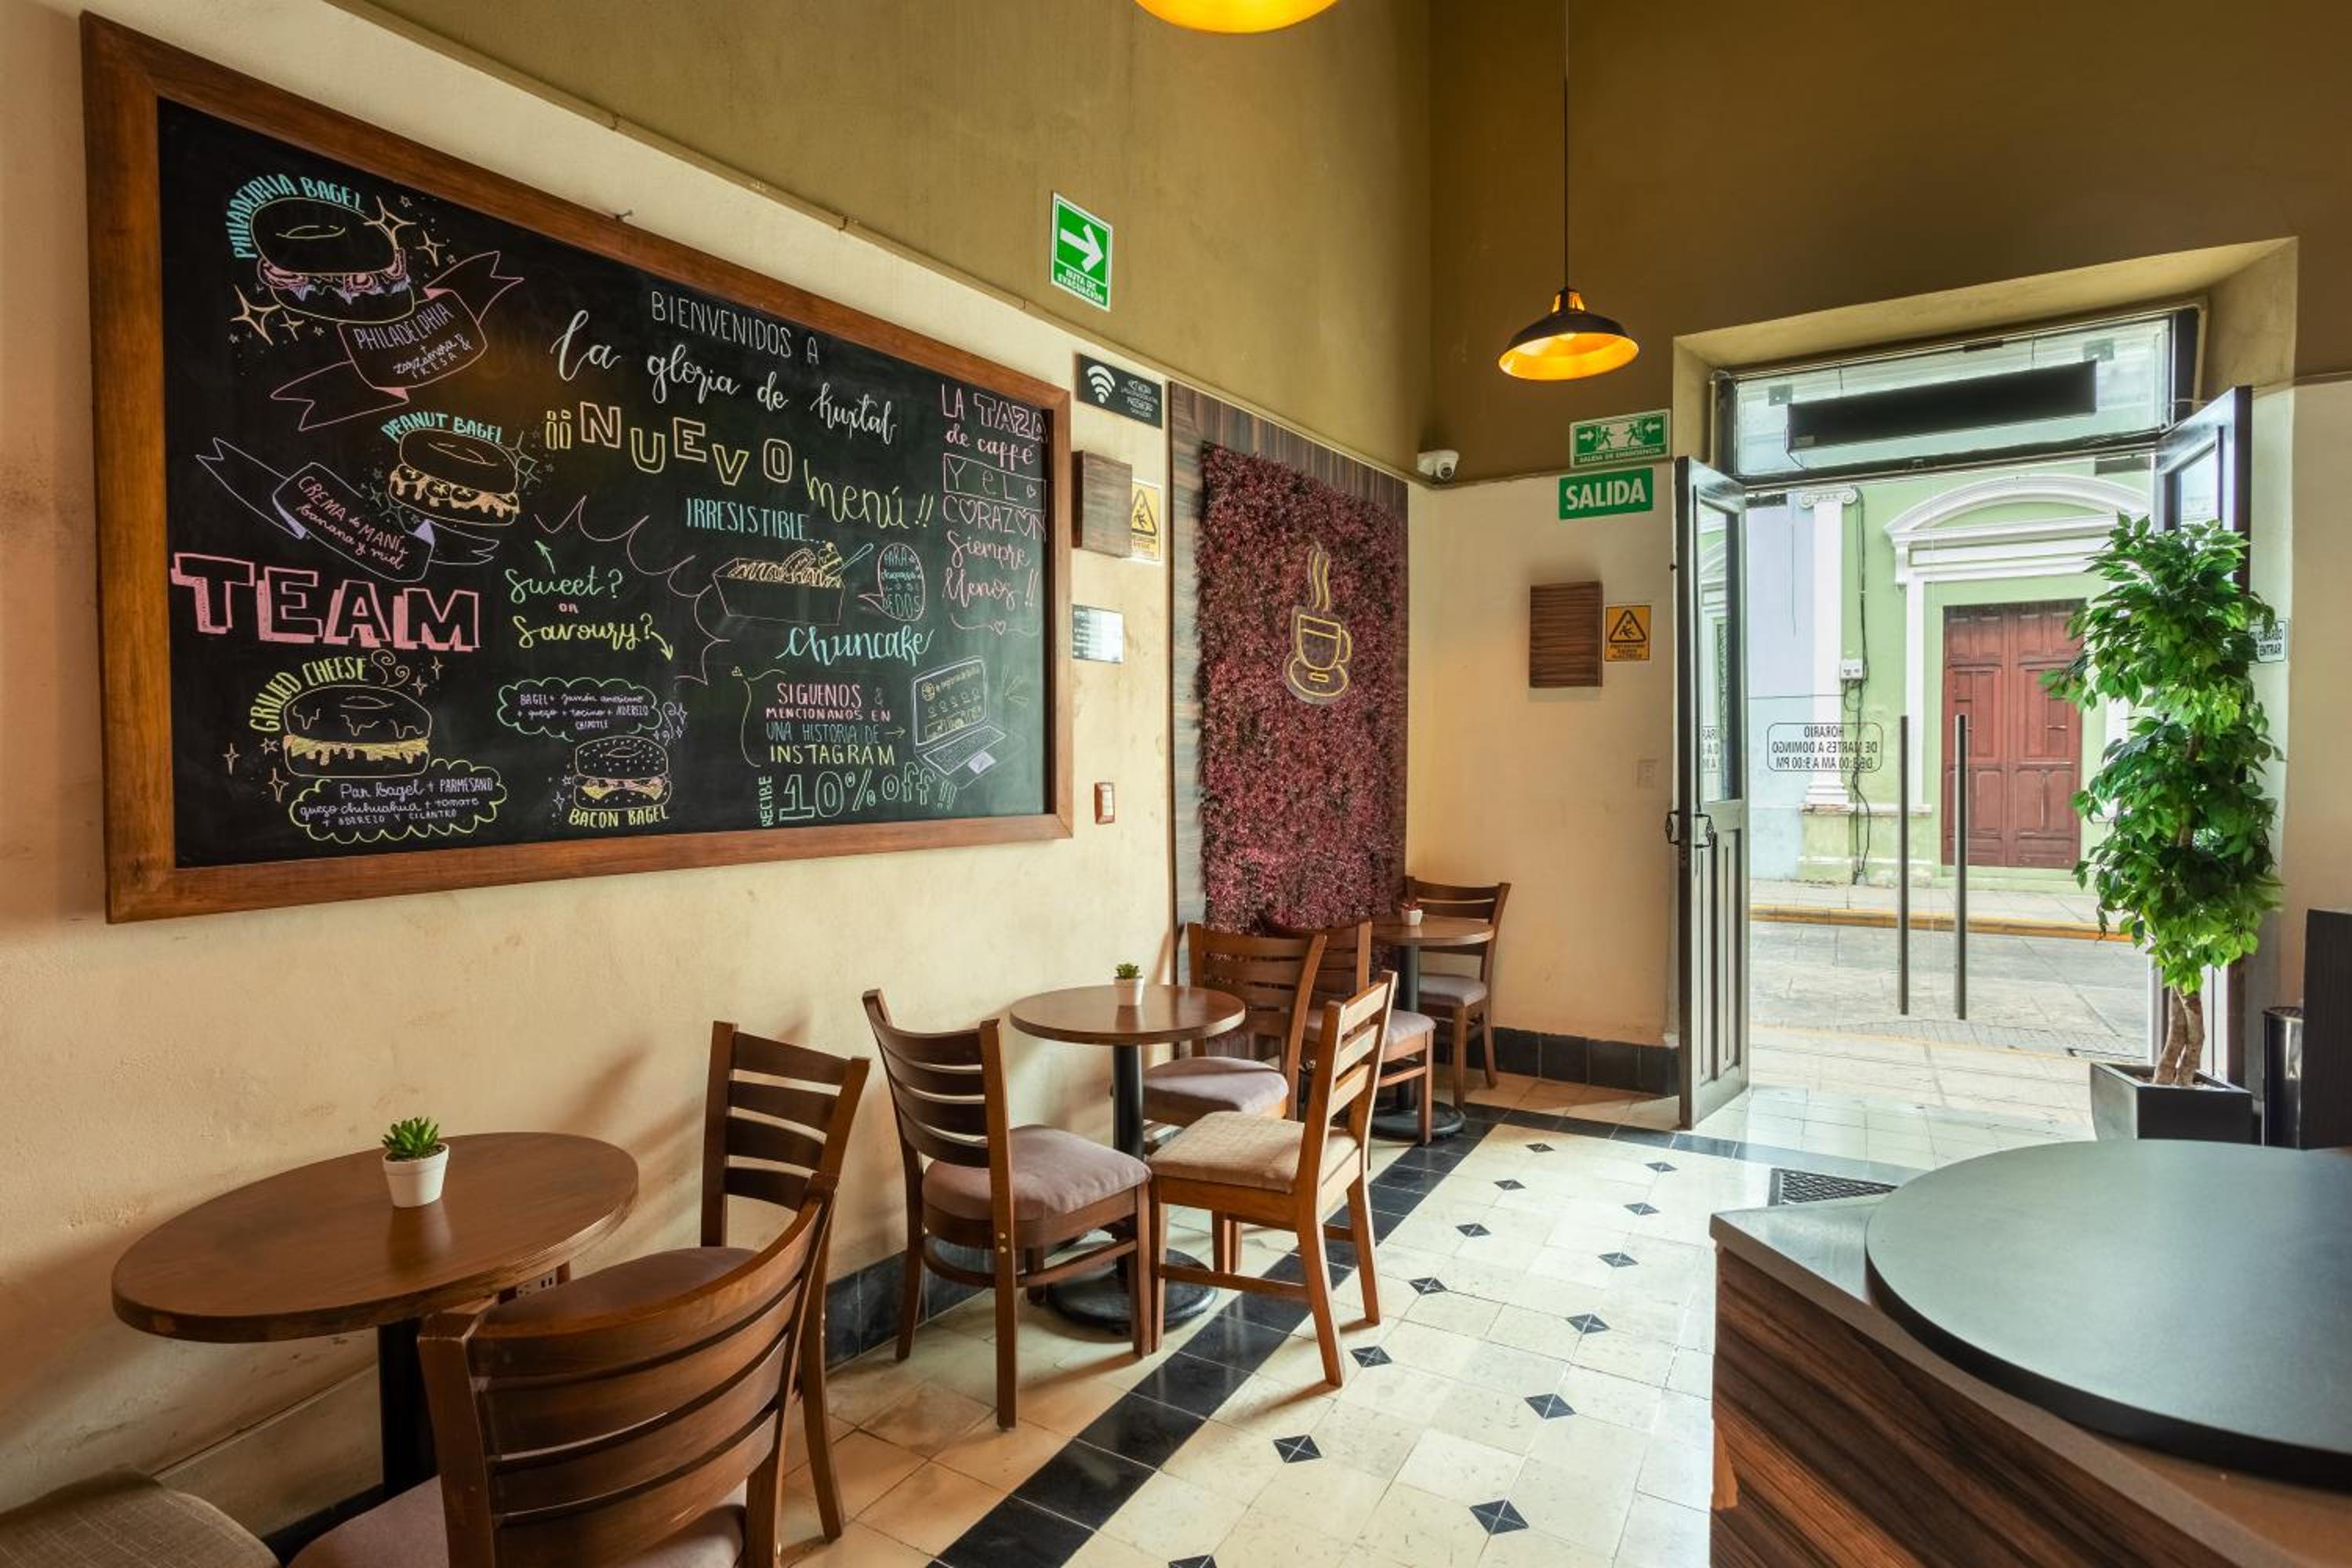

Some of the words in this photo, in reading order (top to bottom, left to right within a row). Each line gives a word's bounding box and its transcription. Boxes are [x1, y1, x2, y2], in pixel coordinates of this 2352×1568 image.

[226, 173, 299, 259] PHILADELPHIA
[299, 176, 365, 213] BAGEL
[353, 302, 454, 350] PHILADELPHIA
[652, 291, 792, 358] BIENVENIDOS
[807, 337, 819, 365] A
[647, 343, 742, 405] gloria
[757, 371, 789, 412] de
[380, 411, 449, 444] PEANUT
[452, 416, 503, 445] BAGEL
[942, 383, 965, 421] LA
[973, 393, 1049, 444] TAZA
[946, 423, 971, 448] de
[946, 457, 967, 490] Y
[1579, 454, 1603, 463] SALIDA
[1606, 452, 1614, 460] DE
[298, 476, 347, 521] CREMA
[1566, 477, 1647, 510] SALIDA
[296, 503, 355, 546] banana
[947, 529, 1032, 571] Siempre
[171, 552, 481, 652] TEAM
[302, 656, 370, 687] CHEESE
[520, 693, 549, 706] BAGEL
[777, 681, 862, 710] SIGUENOS
[528, 709, 559, 720] queso
[765, 707, 864, 721] MENCIONANOS
[871, 710, 891, 722] EN
[765, 720, 793, 742] UNA
[802, 722, 859, 744] HISTORIA
[864, 724, 880, 744] DE
[770, 744, 895, 766] INSTAGRAM
[299, 805, 338, 821] queso
[758, 775, 774, 827] RECIBE
[779, 769, 877, 822] 10%
[568, 808, 619, 829] BACON
[628, 805, 670, 826] BAGEL
